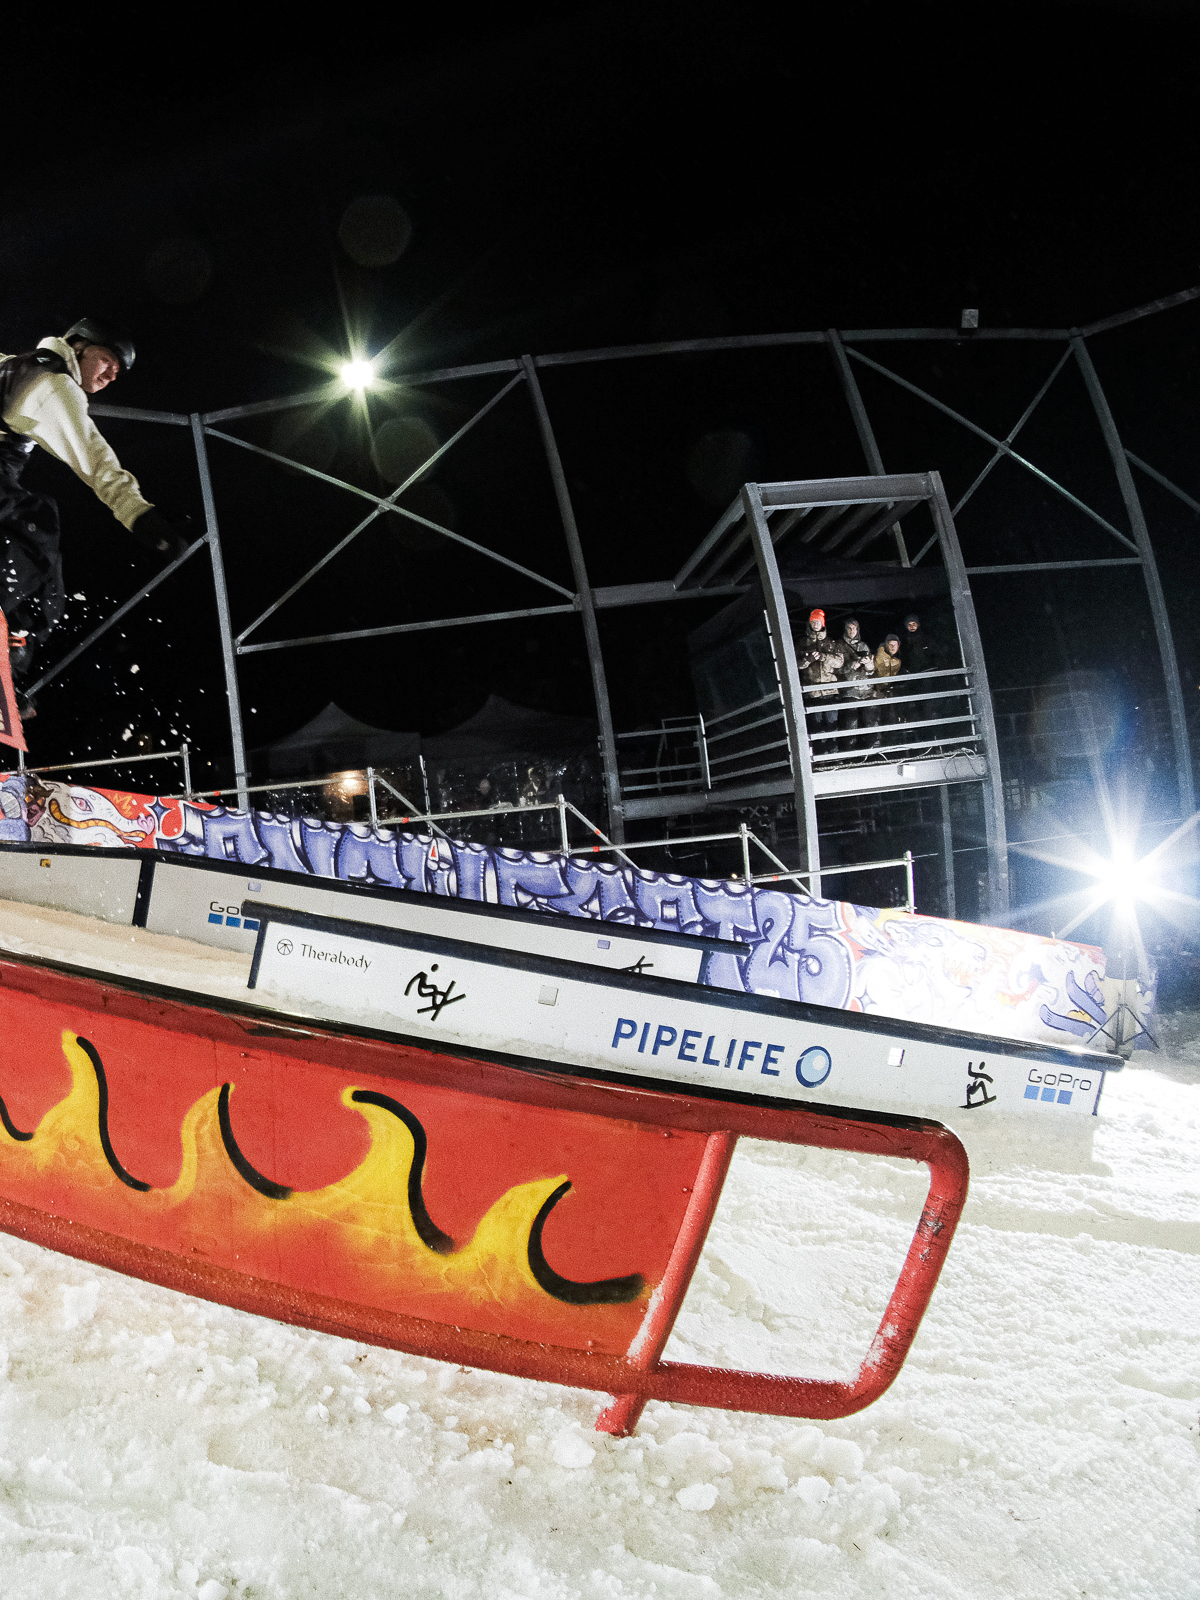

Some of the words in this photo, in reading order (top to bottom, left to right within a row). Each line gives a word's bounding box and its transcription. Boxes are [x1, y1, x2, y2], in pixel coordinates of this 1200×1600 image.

[209, 901, 241, 915] Go
[301, 943, 372, 972] Therabody
[611, 1017, 785, 1077] PIPELIFE
[1028, 1068, 1092, 1091] GoPro
